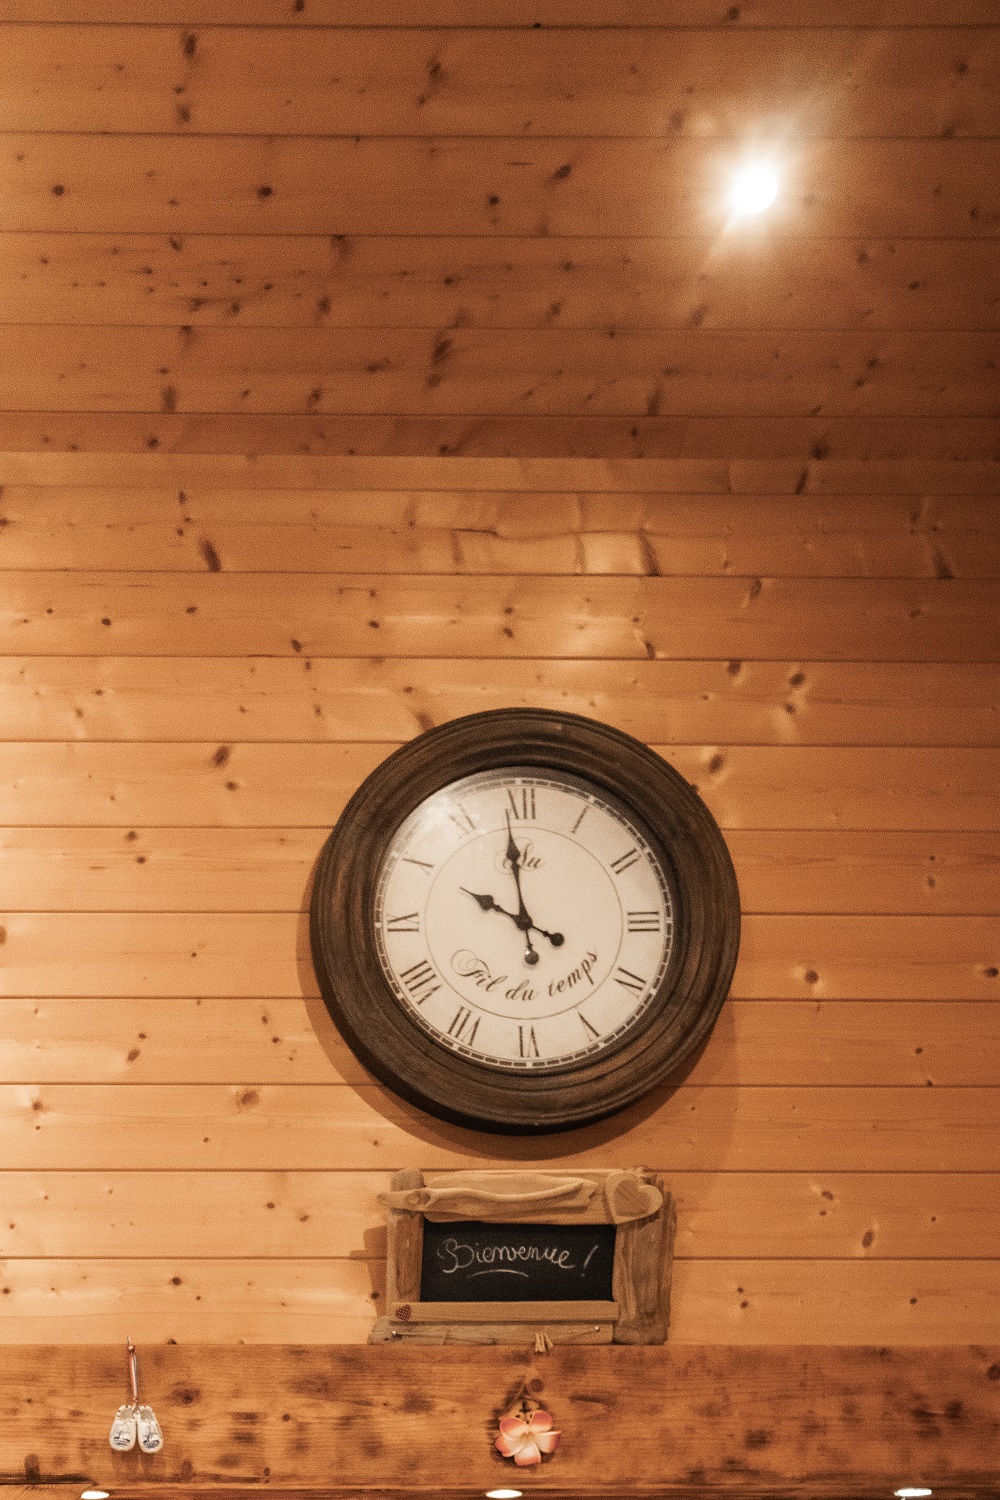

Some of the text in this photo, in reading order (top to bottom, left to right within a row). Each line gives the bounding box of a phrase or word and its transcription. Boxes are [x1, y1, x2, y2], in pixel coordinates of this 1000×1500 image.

[507, 788, 537, 820] XII
[571, 804, 591, 834] I
[610, 847, 643, 874] II
[387, 911, 419, 933] IX
[627, 911, 660, 932] III
[450, 949, 599, 1001] Fil du temps
[517, 1025, 540, 1058] VI
[437, 1238, 575, 1274] Bienvenue
